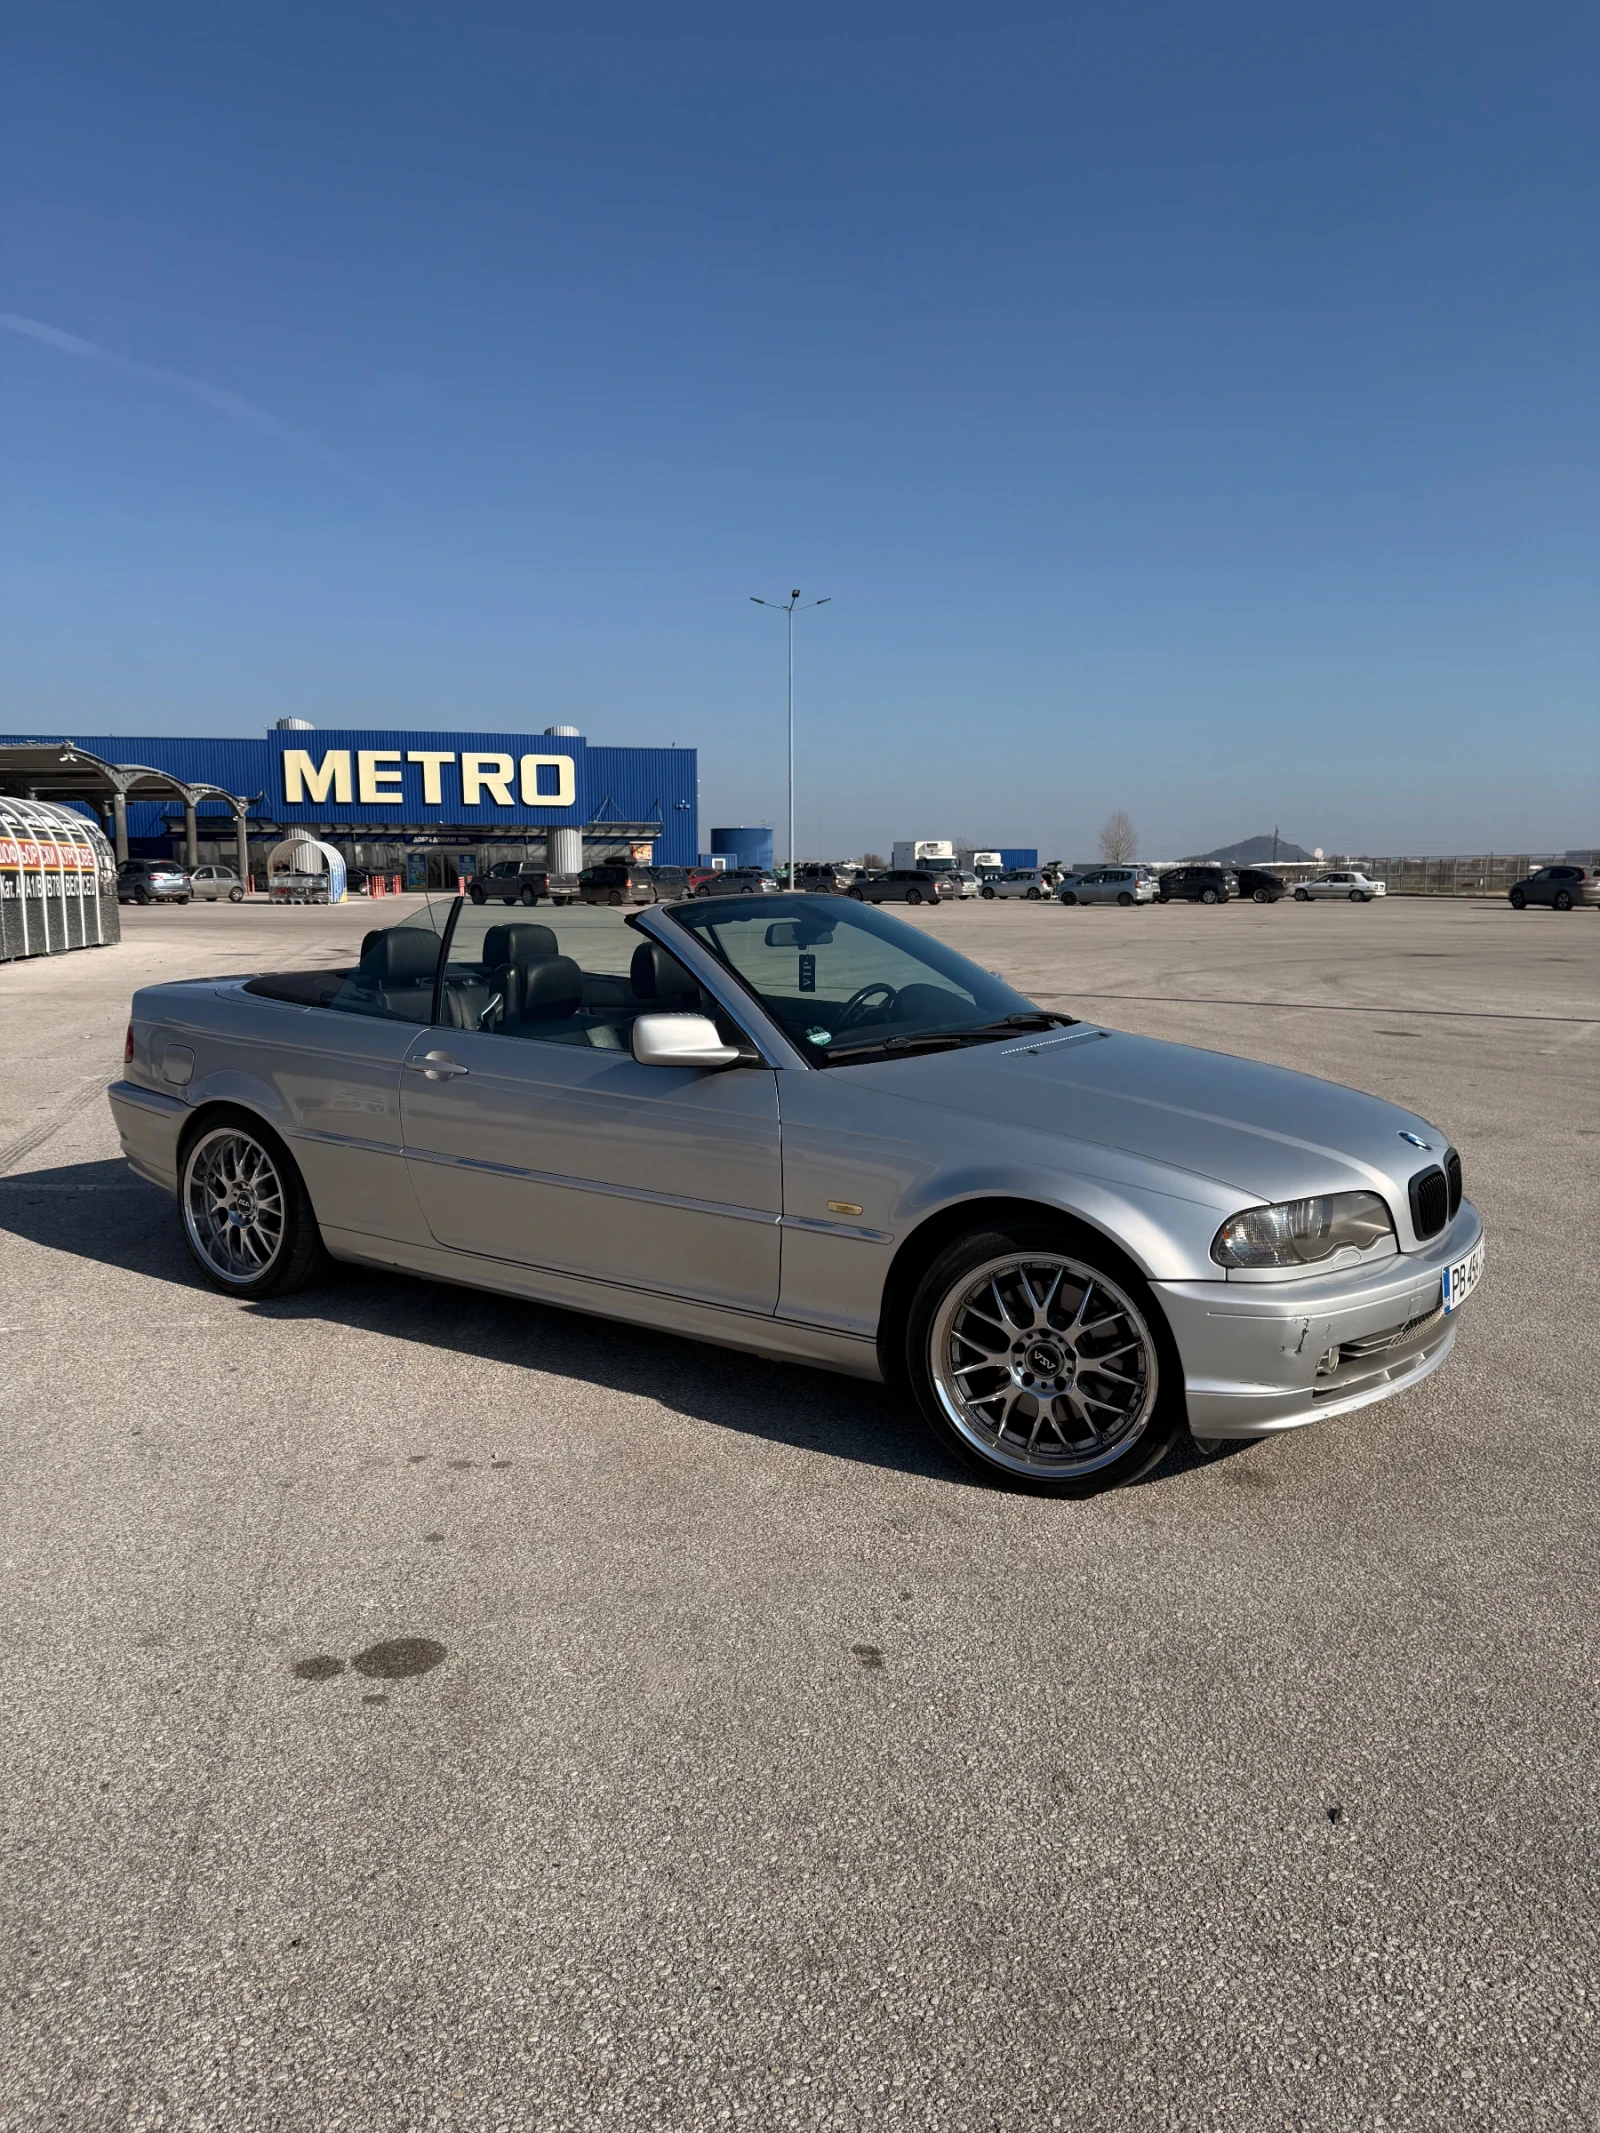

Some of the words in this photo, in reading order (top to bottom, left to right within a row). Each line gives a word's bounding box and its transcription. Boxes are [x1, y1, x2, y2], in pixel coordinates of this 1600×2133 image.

[284, 749, 576, 806] METRO
[803, 961, 811, 986] VIP
[1452, 1264, 1466, 1303] PB
[1034, 1350, 1056, 1369] ASA
